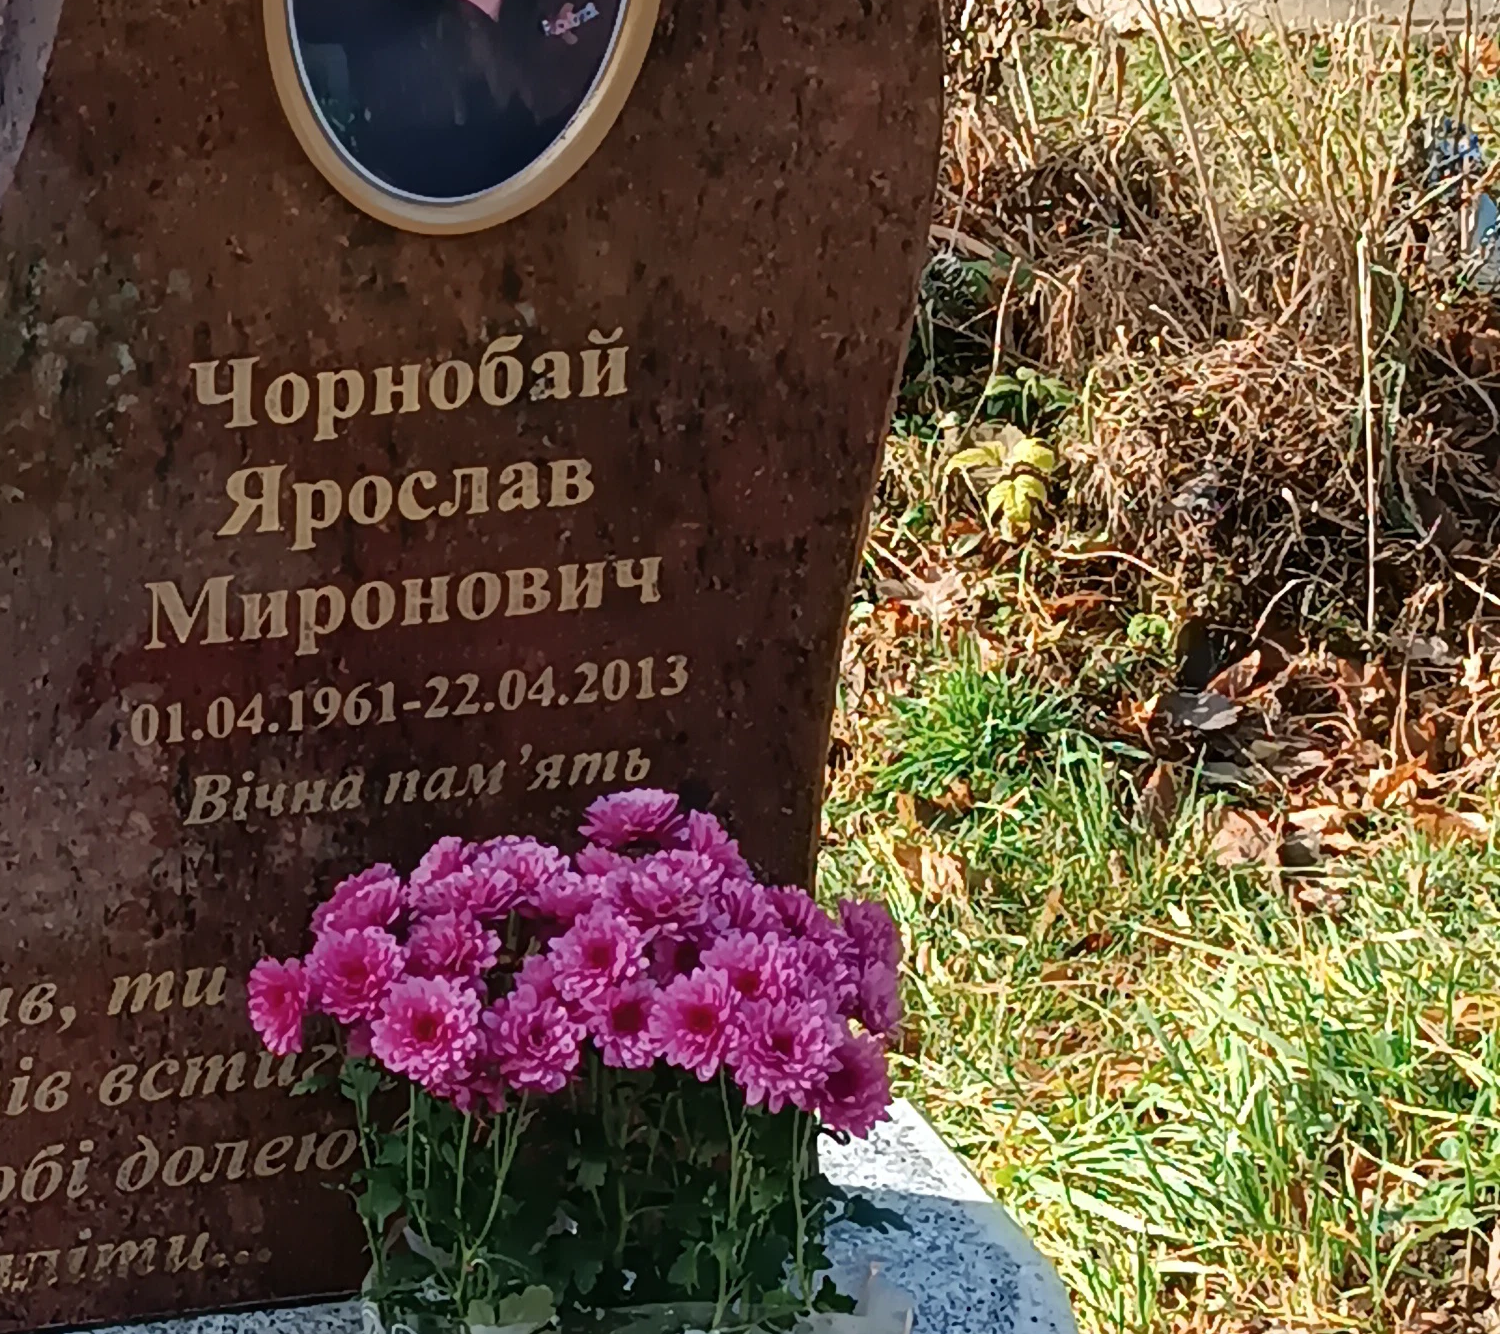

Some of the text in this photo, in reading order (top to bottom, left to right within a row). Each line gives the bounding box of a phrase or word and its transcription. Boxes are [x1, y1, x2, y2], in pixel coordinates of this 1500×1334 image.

[189, 327, 630, 442] Чорнобай
[216, 457, 595, 551] Ярослав
[143, 556, 663, 656] Миронович
[130, 654, 689, 746] 01.04.1961-22.04.2013
[184, 770, 363, 825] Вічна
[107, 966, 227, 1016] ти
[115, 1128, 357, 1192] долею
